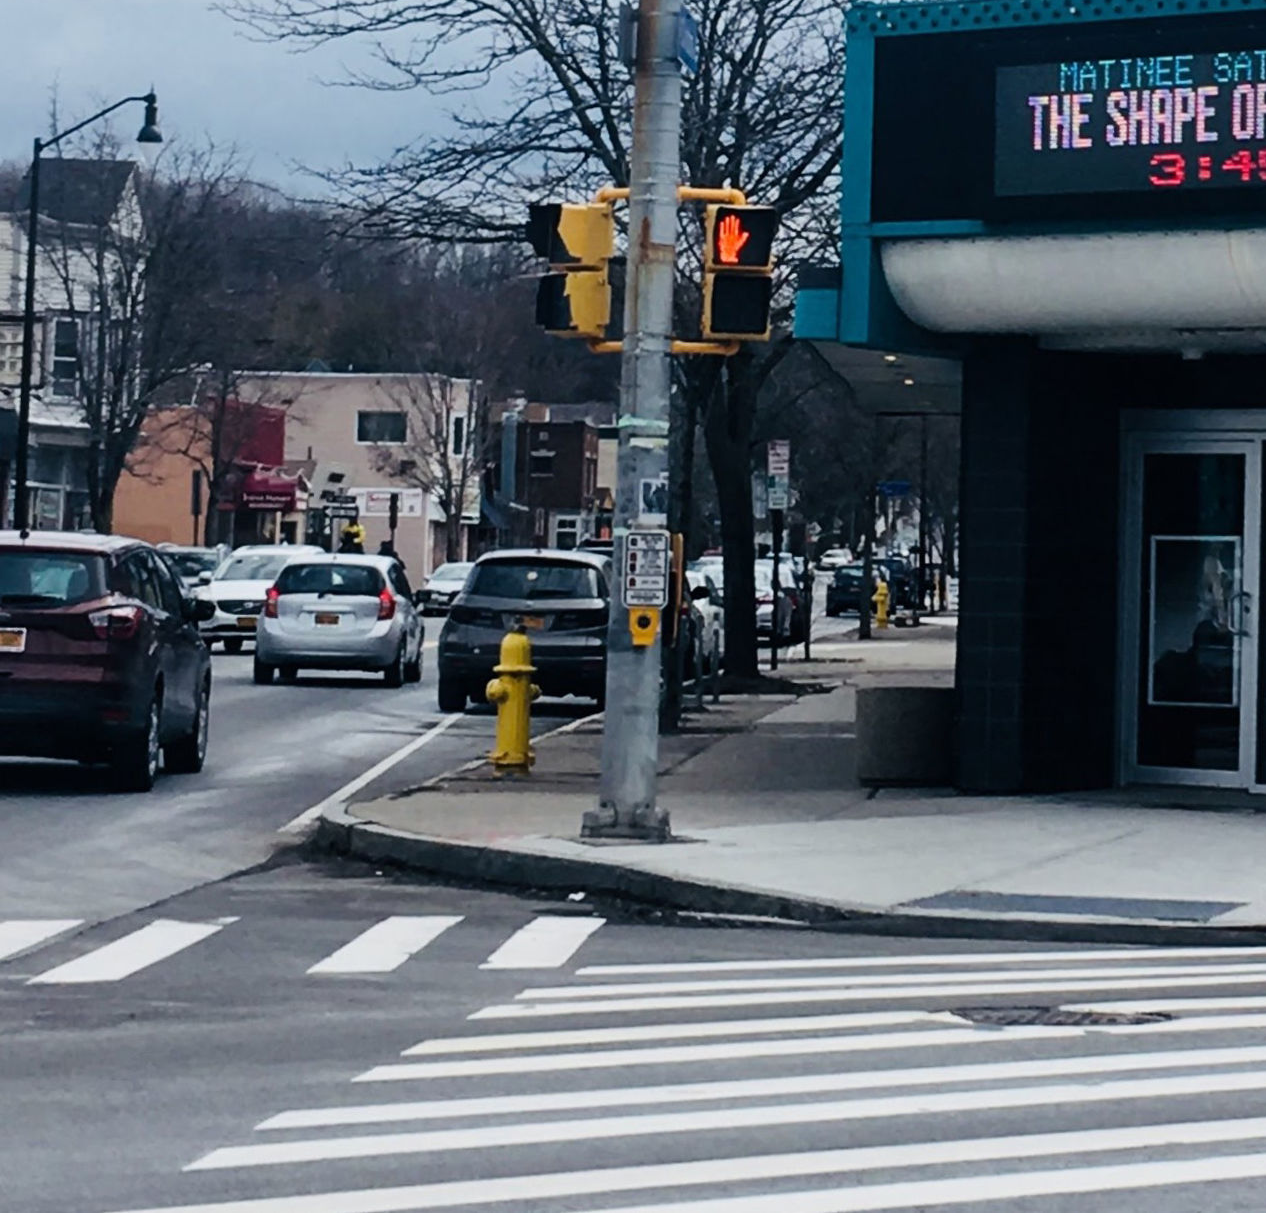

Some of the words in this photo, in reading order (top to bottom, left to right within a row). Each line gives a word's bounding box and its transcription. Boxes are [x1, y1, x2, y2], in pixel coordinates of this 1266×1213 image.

[1060, 55, 1194, 91] MATINEE
[1028, 93, 1093, 150] THE
[1105, 87, 1219, 147] SHAPE
